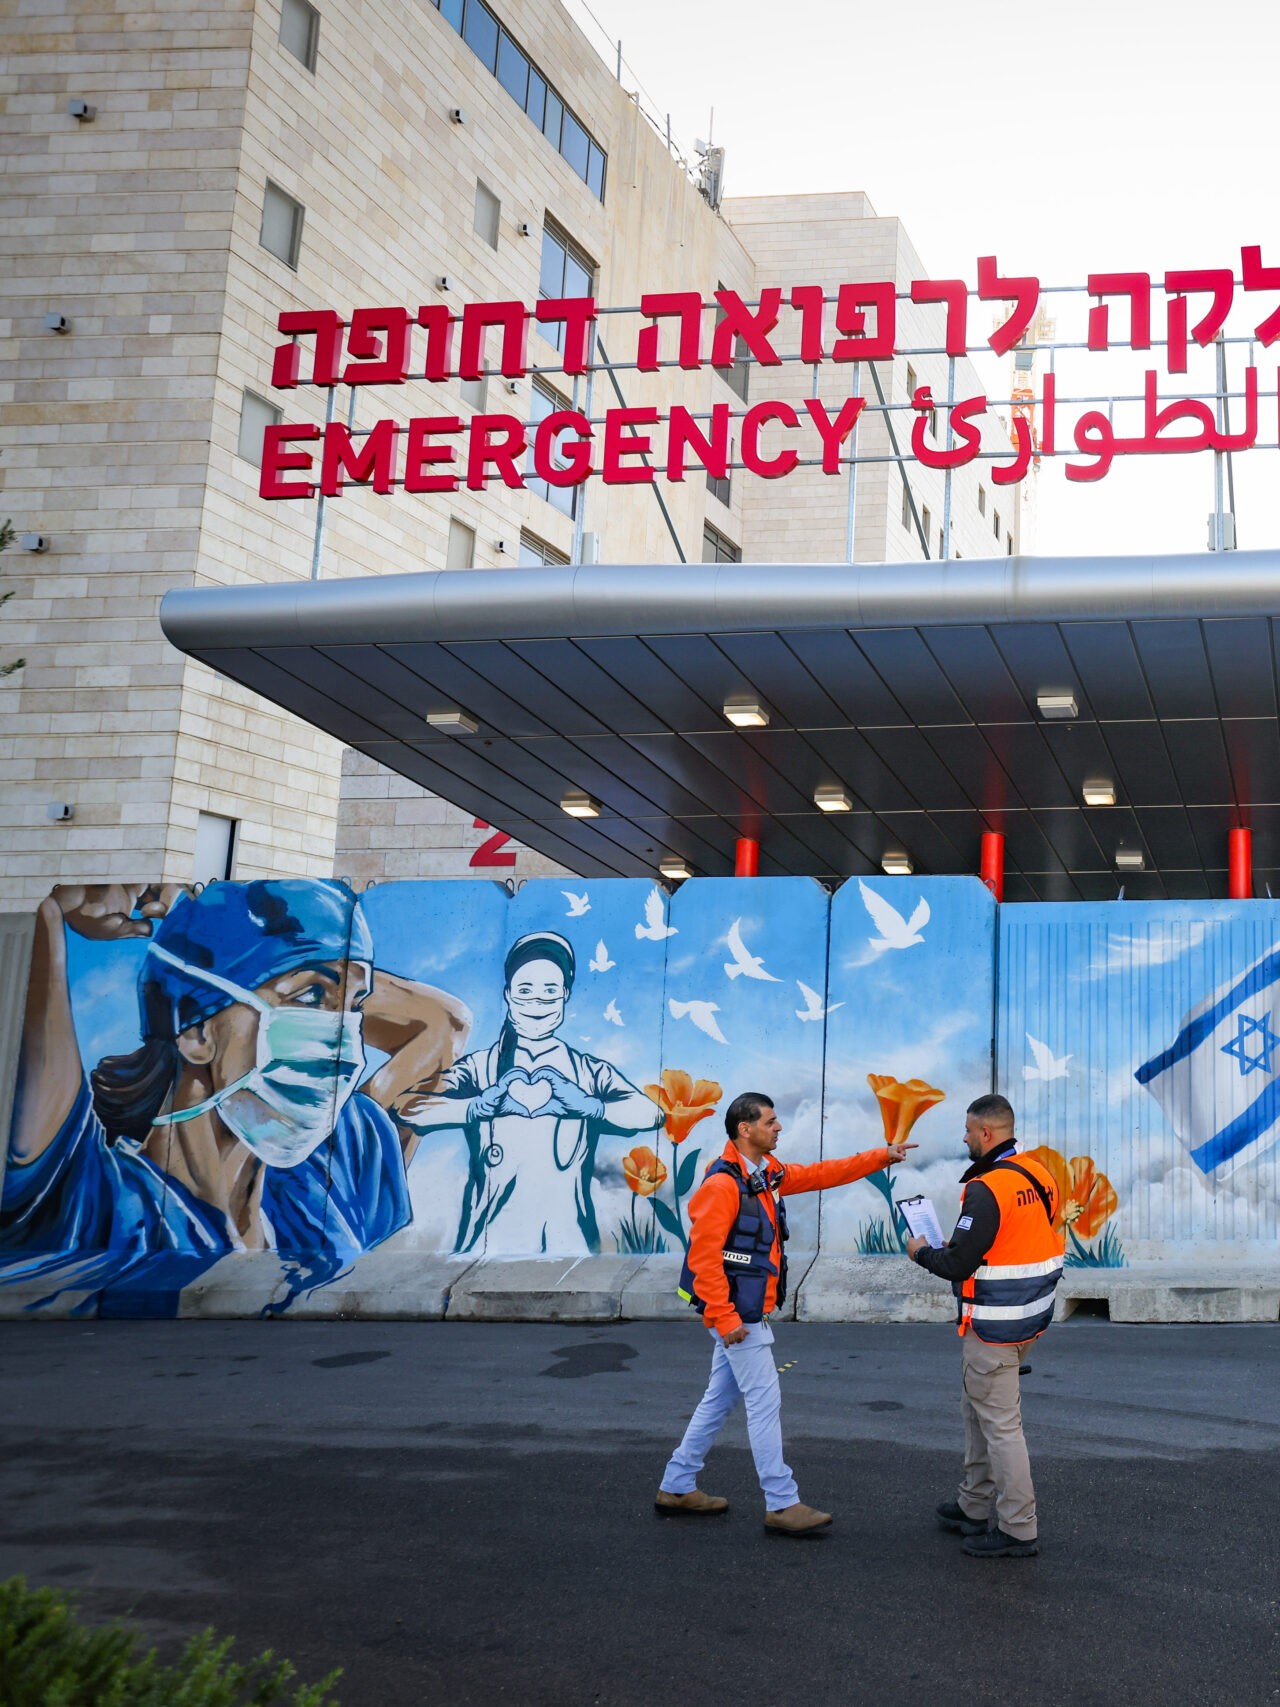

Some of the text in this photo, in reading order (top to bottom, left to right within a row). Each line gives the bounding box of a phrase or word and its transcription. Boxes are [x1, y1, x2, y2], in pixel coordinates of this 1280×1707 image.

[271, 297, 597, 389] דחופה
[637, 256, 1040, 373] לרפואה
[259, 397, 867, 500] EMERGENCY
